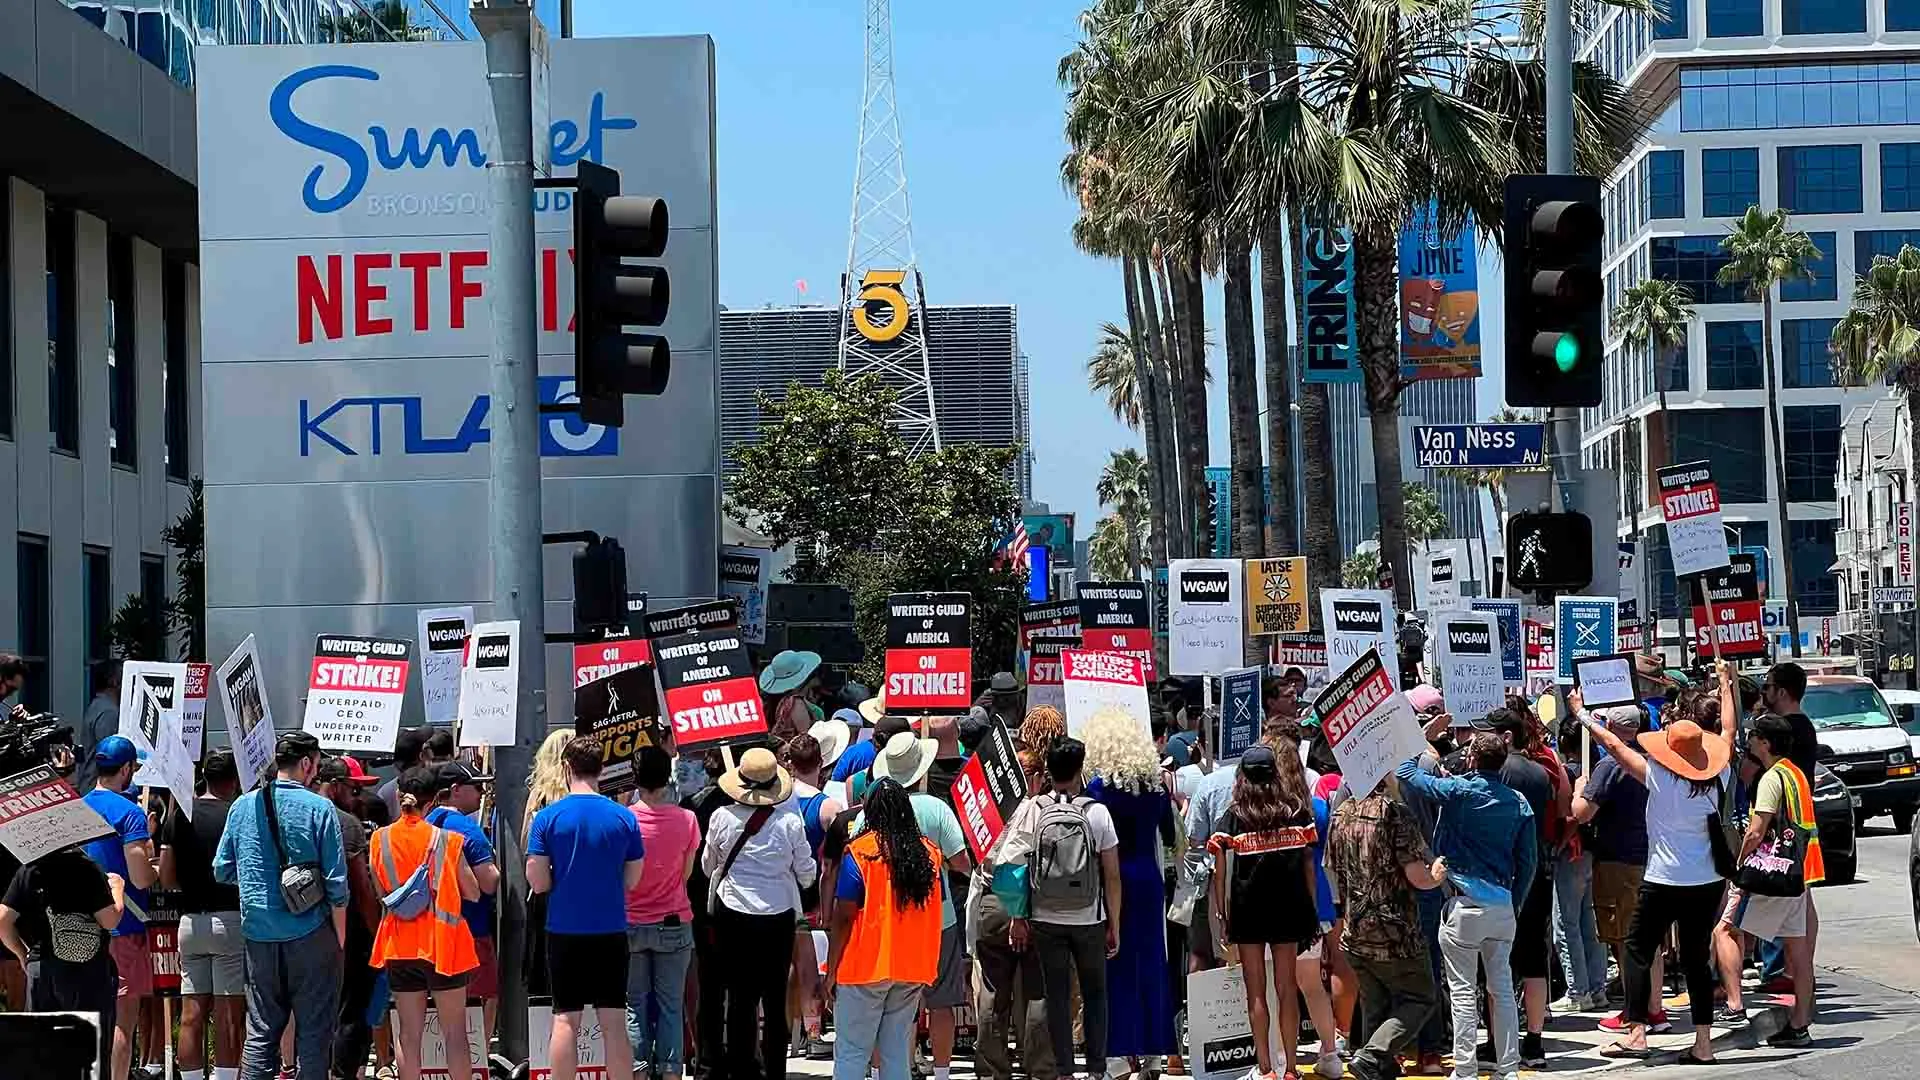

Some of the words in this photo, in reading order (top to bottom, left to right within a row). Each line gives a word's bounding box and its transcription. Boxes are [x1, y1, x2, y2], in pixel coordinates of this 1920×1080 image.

[269, 64, 637, 213] Sunet
[1410, 247, 1464, 276] JUNE
[297, 249, 577, 344] NETFI
[1307, 227, 1350, 370] FRING
[853, 270, 910, 341] 5
[1419, 427, 1455, 449] Van
[1466, 426, 1516, 449] Ness
[1419, 449, 1452, 466] 1400
[1458, 449, 1468, 464] N
[1522, 448, 1539, 464] Av
[1662, 472, 1690, 487] WRITERS
[1690, 469, 1710, 482] GUILD
[1665, 488, 1715, 517] STRIKE!
[1899, 506, 1910, 537] FOR
[724, 561, 759, 576] WGAW
[1261, 561, 1292, 574] IATSE
[1431, 565, 1452, 576] WGAW
[1899, 542, 1911, 583] RENT
[1182, 581, 1228, 593] WGAW
[1719, 577, 1728, 586] OF
[1080, 588, 1118, 599] WRITERS
[1119, 588, 1143, 599] GUILD
[892, 604, 935, 617] WRITERS
[936, 604, 965, 616] GUILD
[1023, 608, 1062, 622] WRITERS
[1062, 604, 1080, 616] GUI
[1109, 602, 1119, 611] OF
[1255, 602, 1301, 615] SUPPORTS
[1720, 608, 1736, 621] ON
[650, 612, 698, 633] WRITERS
[699, 609, 731, 625] GUILD
[922, 619, 934, 629] OF
[1096, 614, 1134, 625] AMERICA
[1336, 610, 1381, 623] WGAW
[429, 628, 465, 642] WGAW
[1263, 622, 1296, 633] RIGHTS
[1699, 620, 1760, 646] SRIKE!
[905, 632, 950, 644] AMERICA
[1111, 634, 1127, 647] ON
[1450, 631, 1489, 645] WGAW
[322, 639, 371, 653] WRITERS
[372, 642, 406, 655] GUILD
[478, 644, 509, 659] WGAW
[603, 647, 620, 661] ON
[659, 642, 708, 660] WRITERS
[708, 638, 740, 652] GUILD
[1333, 637, 1359, 657] RUN
[696, 656, 709, 666] OF
[919, 655, 937, 669] ON
[1069, 652, 1135, 668] WRITERS
[1281, 648, 1328, 664] STRIKE!
[682, 665, 731, 682] AMERICA
[1071, 660, 1119, 673] GUILD
[228, 663, 255, 699] WGAW
[315, 662, 401, 689] STRIKE!
[888, 671, 966, 696] STRIKE!
[1070, 668, 1139, 684] AMERICA
[1318, 680, 1353, 715] WRITERS
[1351, 658, 1376, 684] GUILD
[319, 697, 386, 709] OVERPAID:
[702, 688, 723, 703] ON
[336, 710, 364, 719] CEO
[673, 699, 760, 733] STRIKE!
[1328, 674, 1388, 744] STRIKE!
[144, 698, 155, 740] WGAW
[314, 721, 383, 733] UNDERPAID:
[596, 716, 653, 742] PPORTS
[321, 732, 372, 744] WRITER
[1343, 737, 1358, 757] UTLA
[992, 726, 1011, 770] WRITERS
[1006, 767, 1022, 798] GUILD
[15, 770, 50, 786] GUILD
[995, 765, 1004, 778] OF
[984, 760, 1005, 805] AMERICA
[0, 783, 72, 819] TRIKE!
[977, 788, 989, 809] ON
[957, 773, 993, 853] STRIKE!
[156, 933, 172, 948] ON
